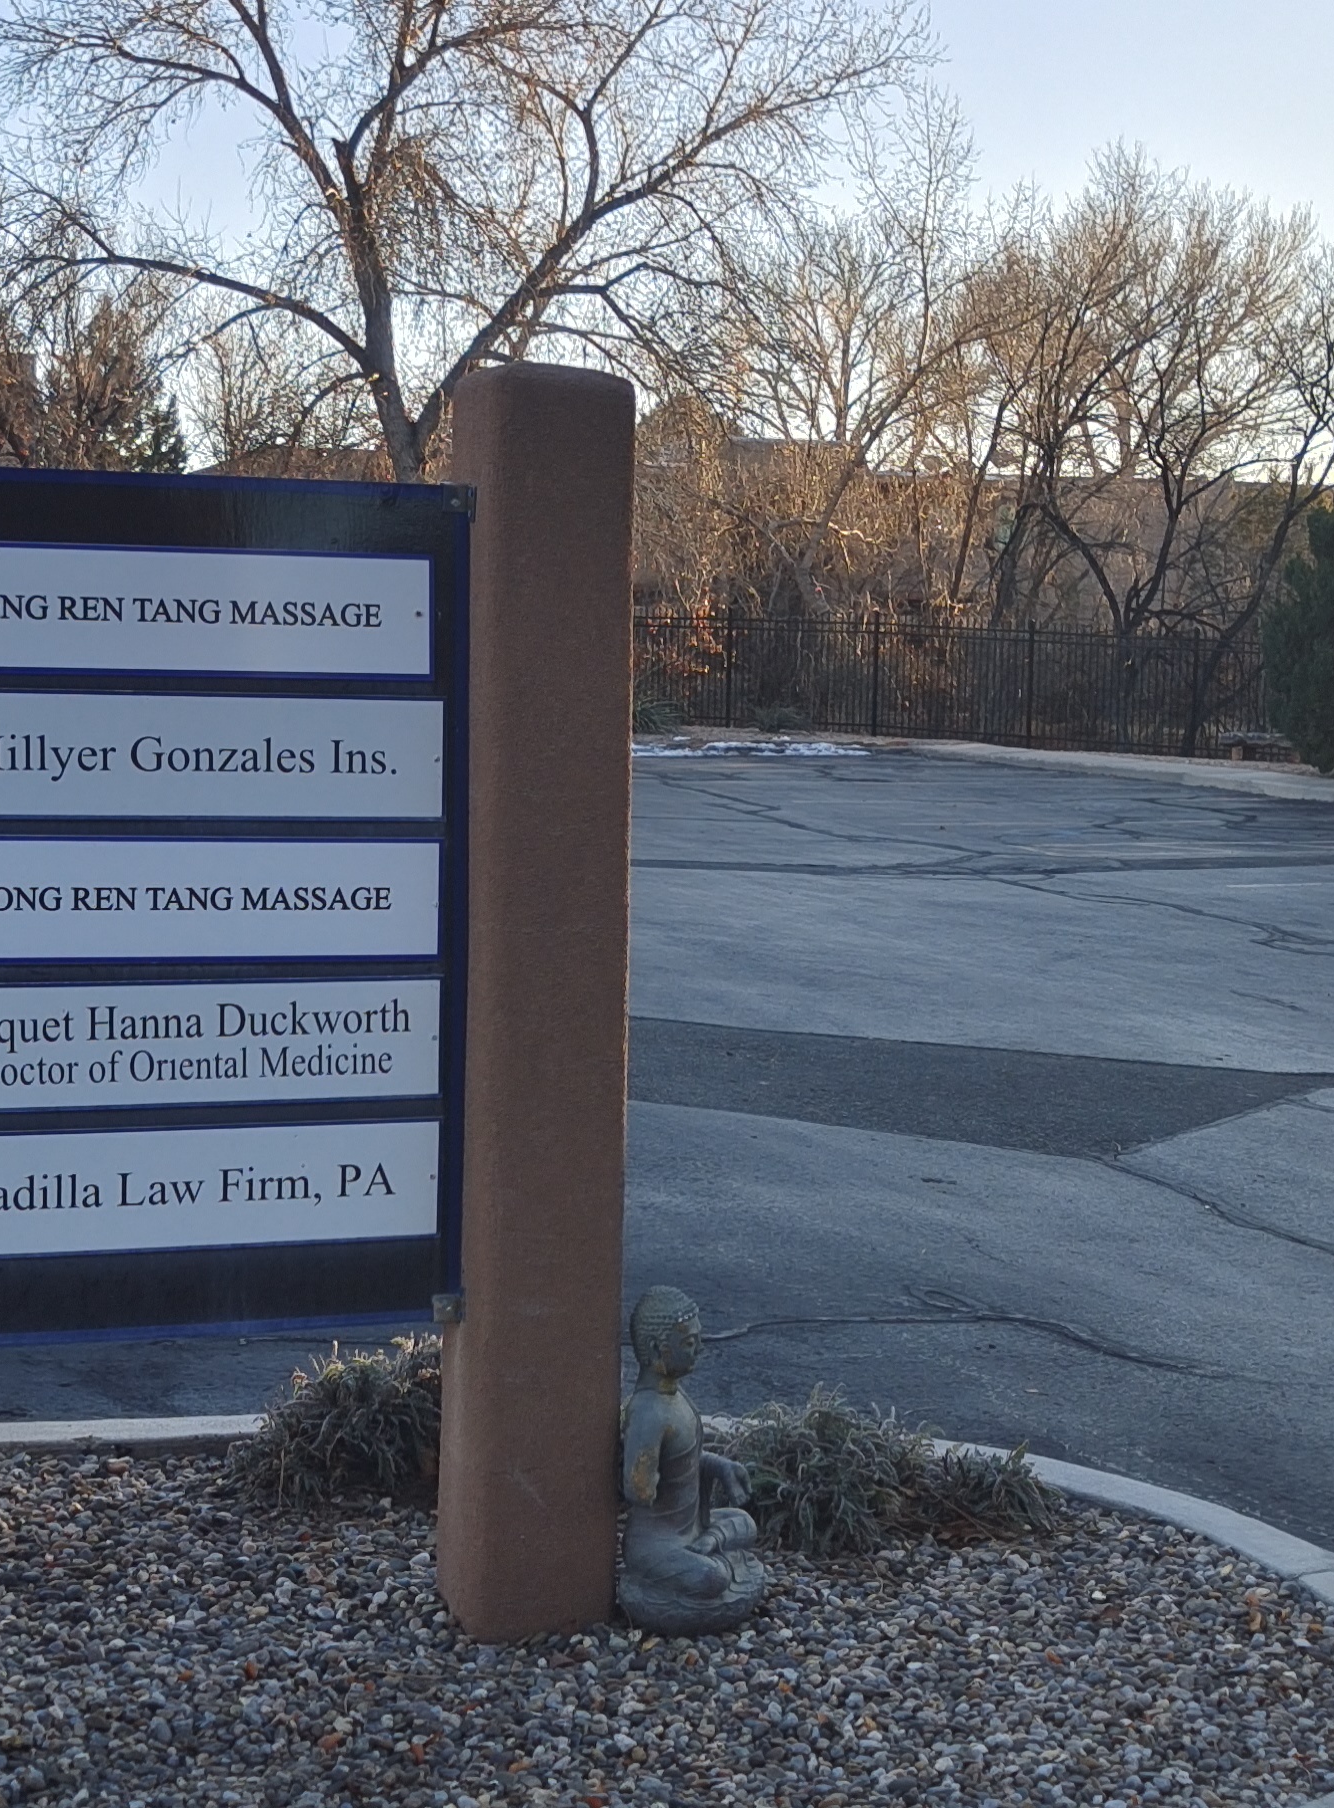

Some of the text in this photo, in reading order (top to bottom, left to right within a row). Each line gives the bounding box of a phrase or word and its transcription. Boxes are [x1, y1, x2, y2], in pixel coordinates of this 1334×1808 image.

[57, 595, 125, 622] REN
[132, 597, 222, 625] TANG
[229, 600, 383, 628] MASSAGE
[130, 735, 315, 774] Gonzales
[330, 739, 398, 775] Ins.
[70, 886, 138, 911] REN
[145, 886, 234, 911] TANG
[240, 886, 392, 911] MASSAGE
[86, 1005, 204, 1041] Hanna
[216, 998, 411, 1037] Duckworth
[88, 1050, 123, 1083] of
[129, 1046, 248, 1082] Oriental
[259, 1043, 393, 1078] Medicine
[117, 1172, 205, 1207] Law
[219, 1167, 323, 1206] Firm,
[337, 1162, 396, 1198] PA
